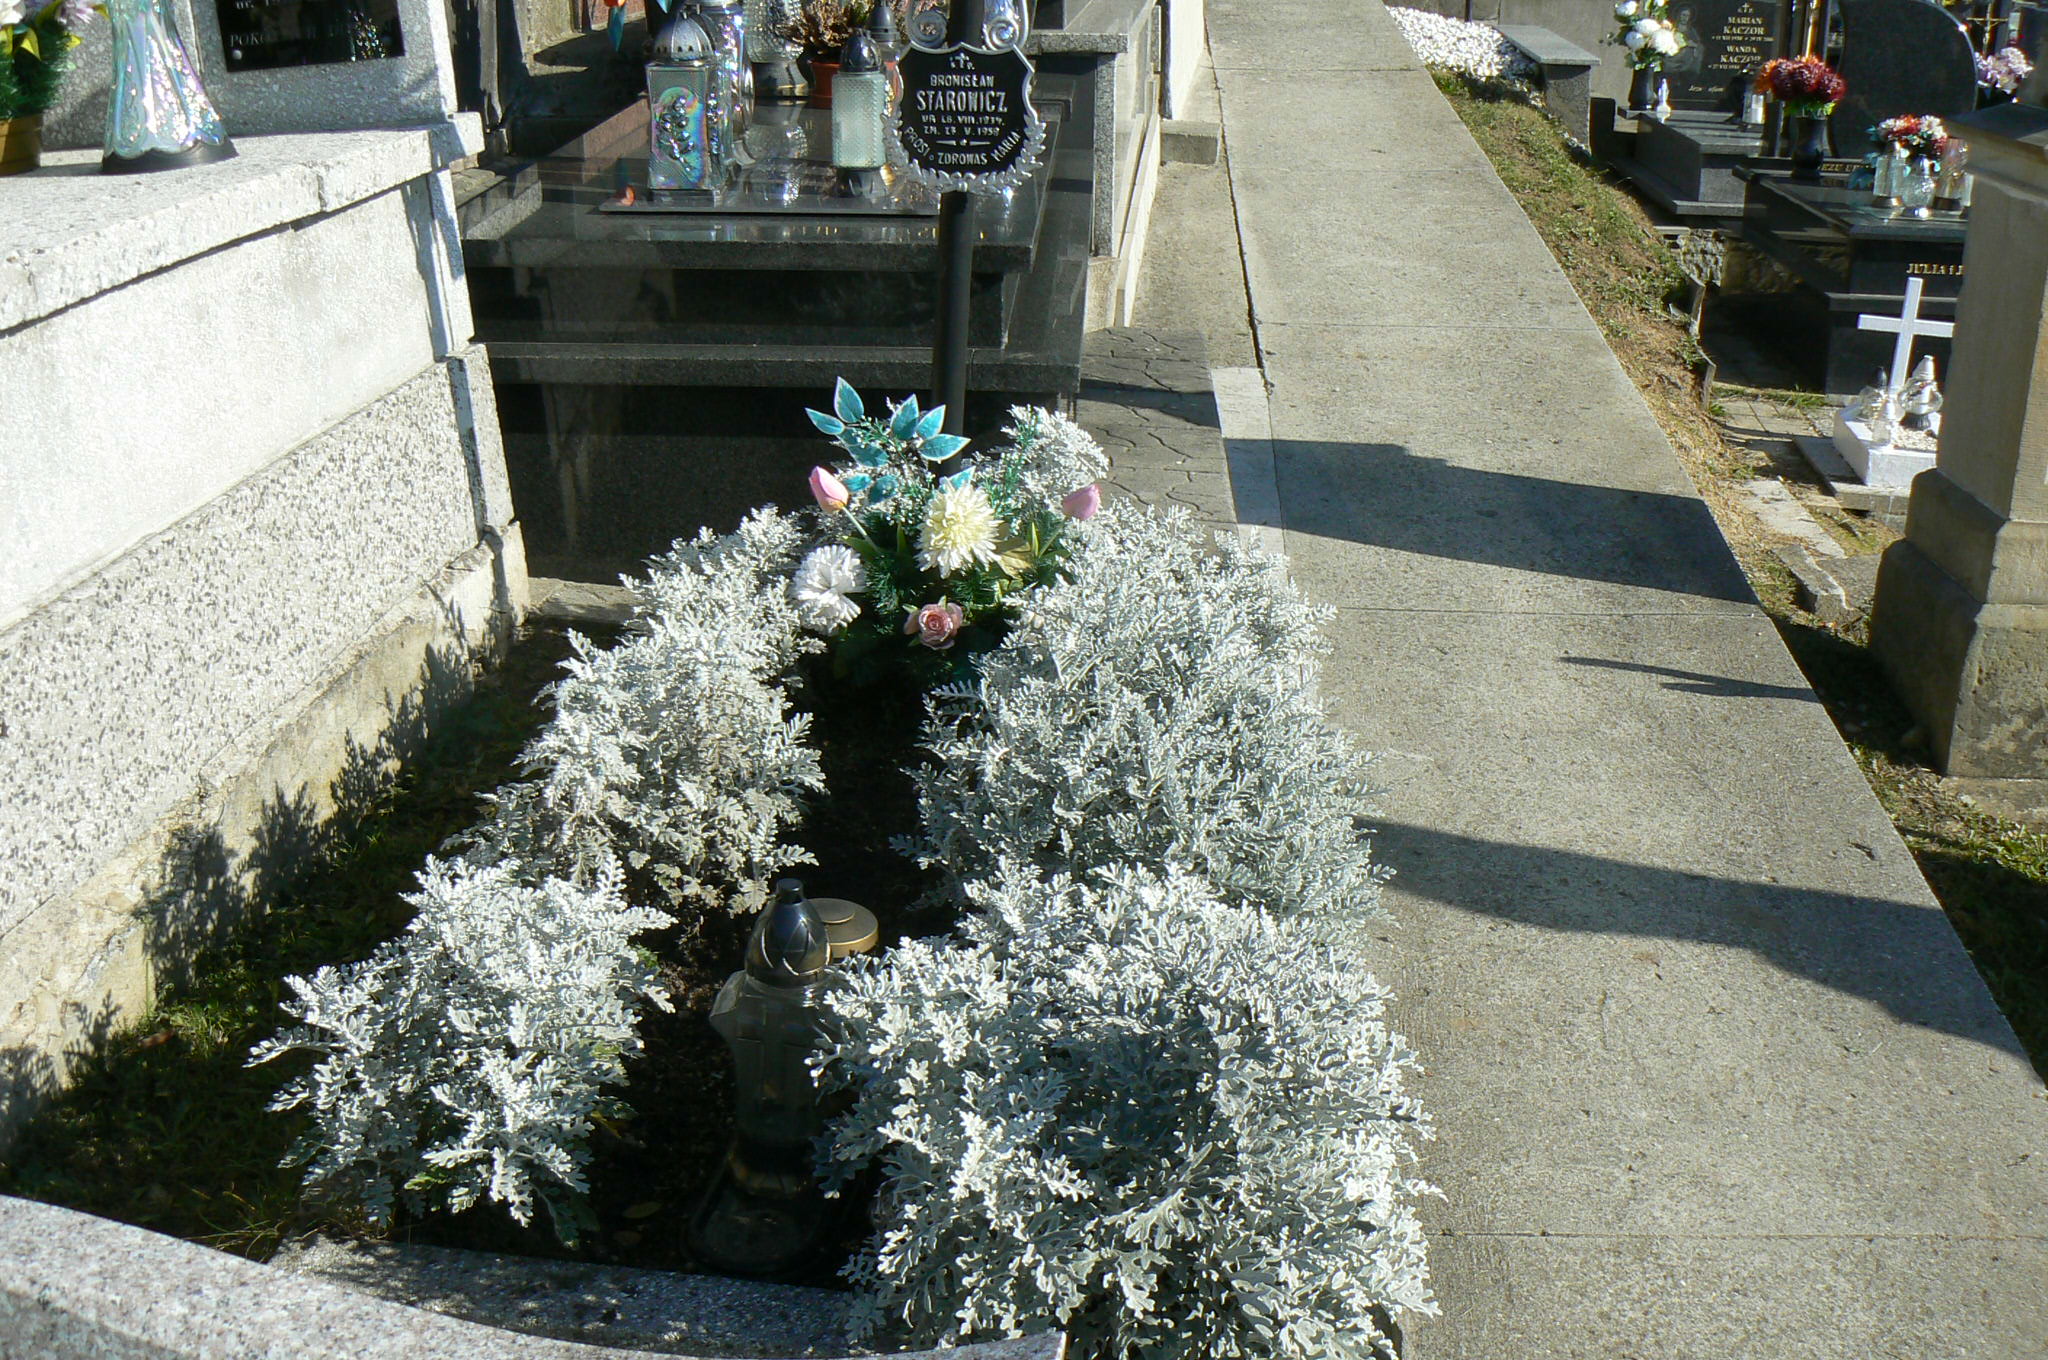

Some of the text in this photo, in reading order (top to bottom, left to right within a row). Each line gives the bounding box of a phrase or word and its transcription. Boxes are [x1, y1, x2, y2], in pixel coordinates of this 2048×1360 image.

[1727, 16, 1763, 25] MARIAN
[1723, 25, 1765, 35] KACZOR
[1726, 45, 1758, 53] WANDA
[930, 74, 995, 87] BRONISŁAW
[916, 90, 1008, 113] STAROWICZ
[904, 126, 931, 157] PROSI
[990, 130, 1021, 162] MARIA
[1905, 263, 1947, 275] JULIA
